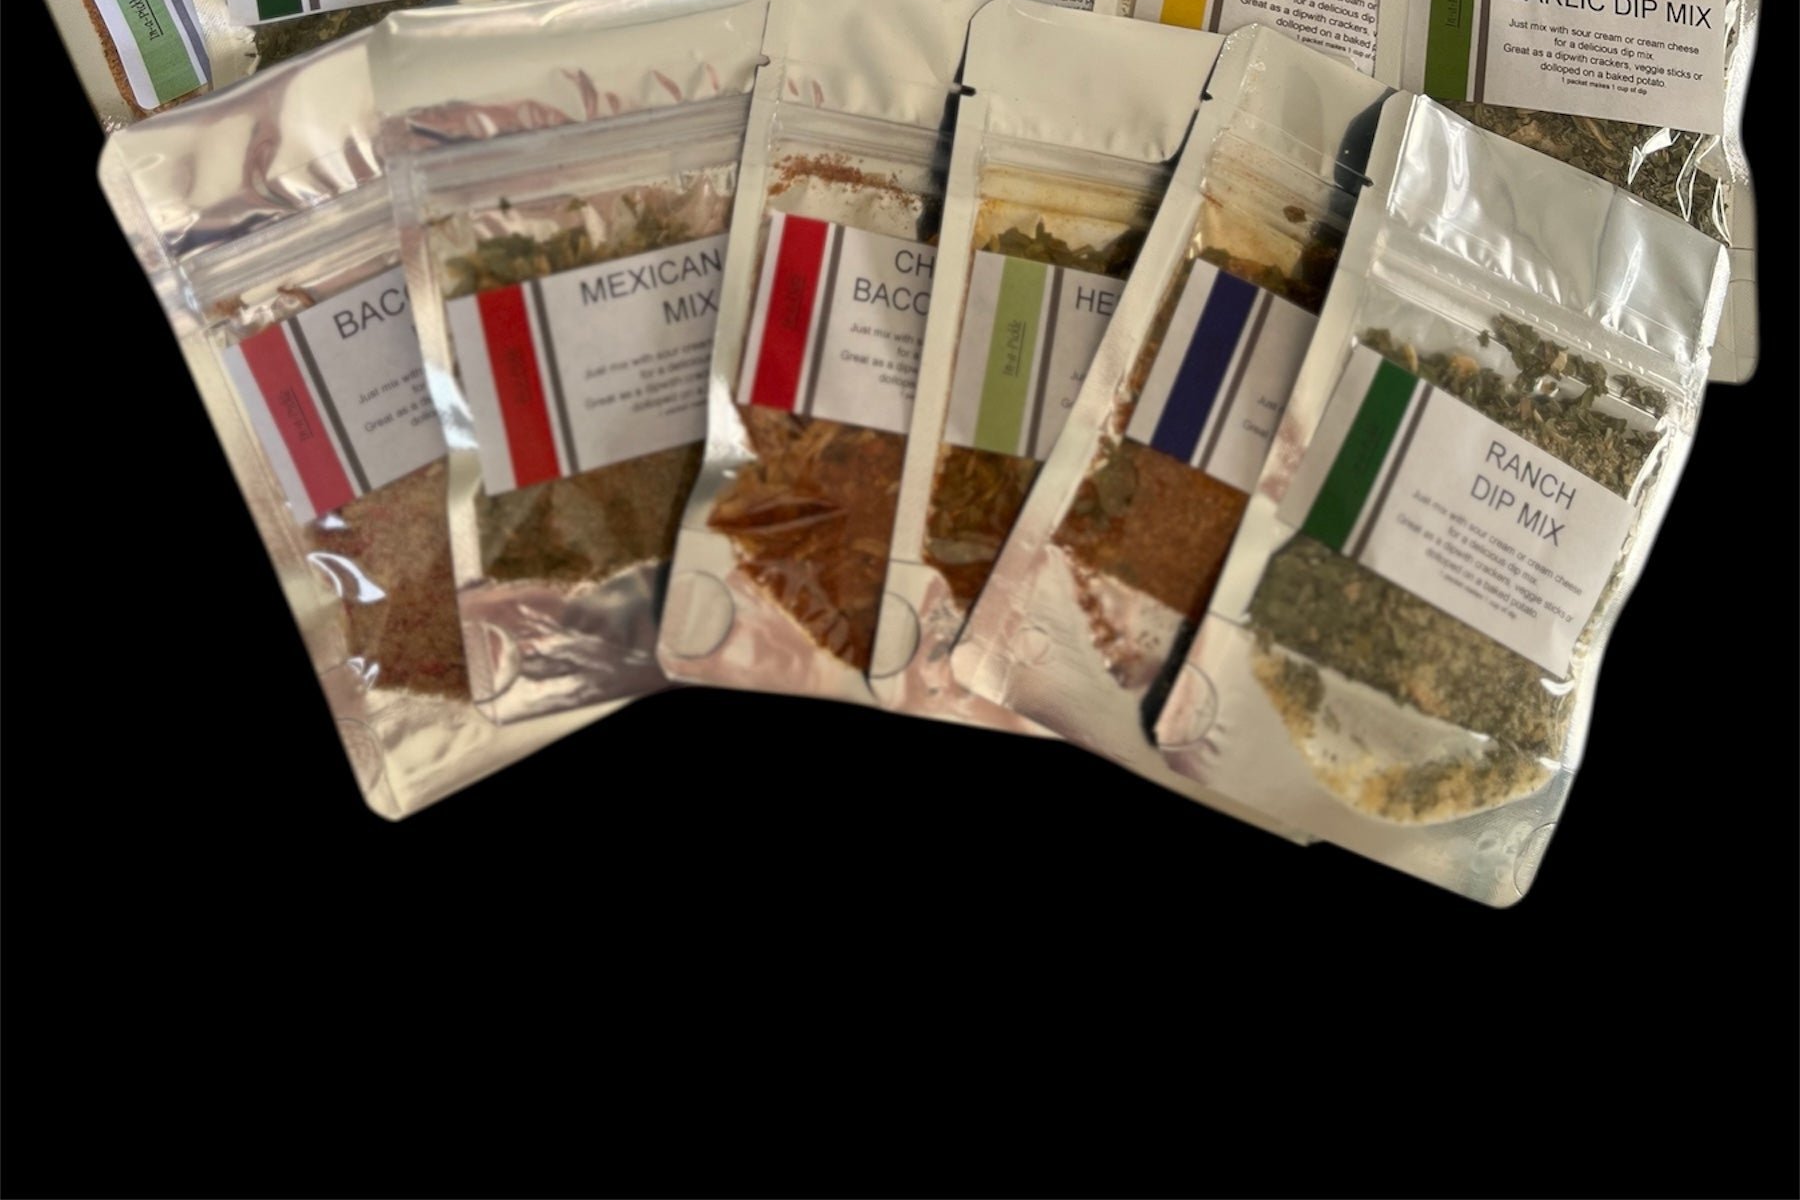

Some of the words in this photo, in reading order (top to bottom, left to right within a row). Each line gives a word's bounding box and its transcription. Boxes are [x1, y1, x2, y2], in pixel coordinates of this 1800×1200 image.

[1667, 2, 1711, 29] MIX
[1508, 18, 1528, 30] Just
[1530, 23, 1547, 32] mix
[1549, 26, 1569, 35] with
[1571, 28, 1592, 38] sour
[1593, 32, 1623, 42] cream
[1624, 36, 1635, 45] or
[1636, 38, 1665, 49] cream
[1667, 42, 1700, 55] cheese
[1554, 37, 1567, 47] for
[1569, 41, 1576, 49] a
[1577, 42, 1618, 55] delicious
[1620, 47, 1635, 59] dip
[1503, 42, 1530, 55] Great
[1532, 48, 1544, 58] as
[1545, 50, 1553, 59] a
[1634, 64, 1665, 76] veggie
[1666, 68, 1692, 80] sticks
[1693, 72, 1703, 81] or
[1540, 62, 1581, 76] dolloped
[1582, 68, 1595, 78] on
[1597, 71, 1604, 79] a
[1605, 71, 1635, 83] baked
[581, 252, 721, 302] MEXICAN
[334, 281, 410, 338] BAC
[663, 290, 718, 323] MIX
[1076, 287, 1121, 317] HE
[1486, 441, 1576, 509] RANCH
[1471, 474, 1516, 510] DIP
[1517, 502, 1565, 546] MIX
